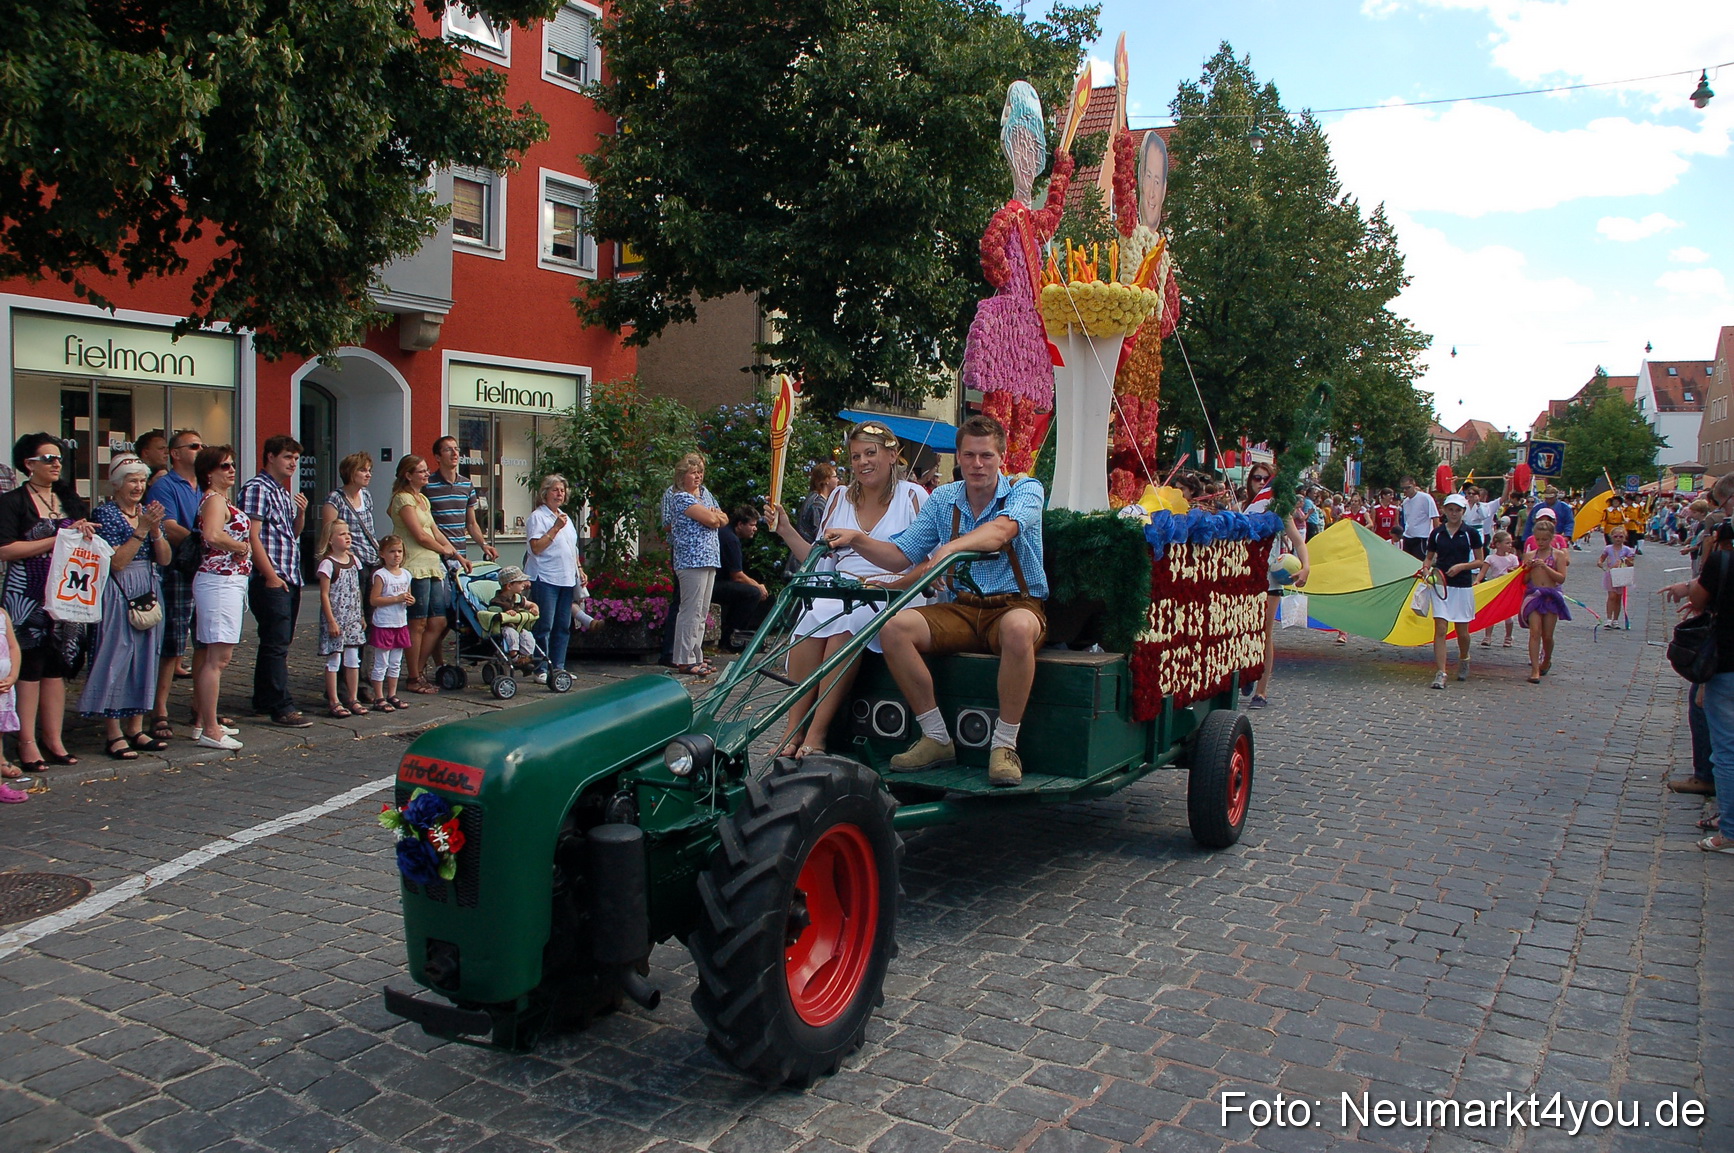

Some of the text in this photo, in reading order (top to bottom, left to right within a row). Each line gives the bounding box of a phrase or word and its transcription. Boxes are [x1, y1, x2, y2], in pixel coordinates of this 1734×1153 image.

[64, 334, 195, 378] fielmann
[475, 378, 554, 409] fielmann
[67, 570, 90, 592] M
[403, 759, 474, 791] Holder
